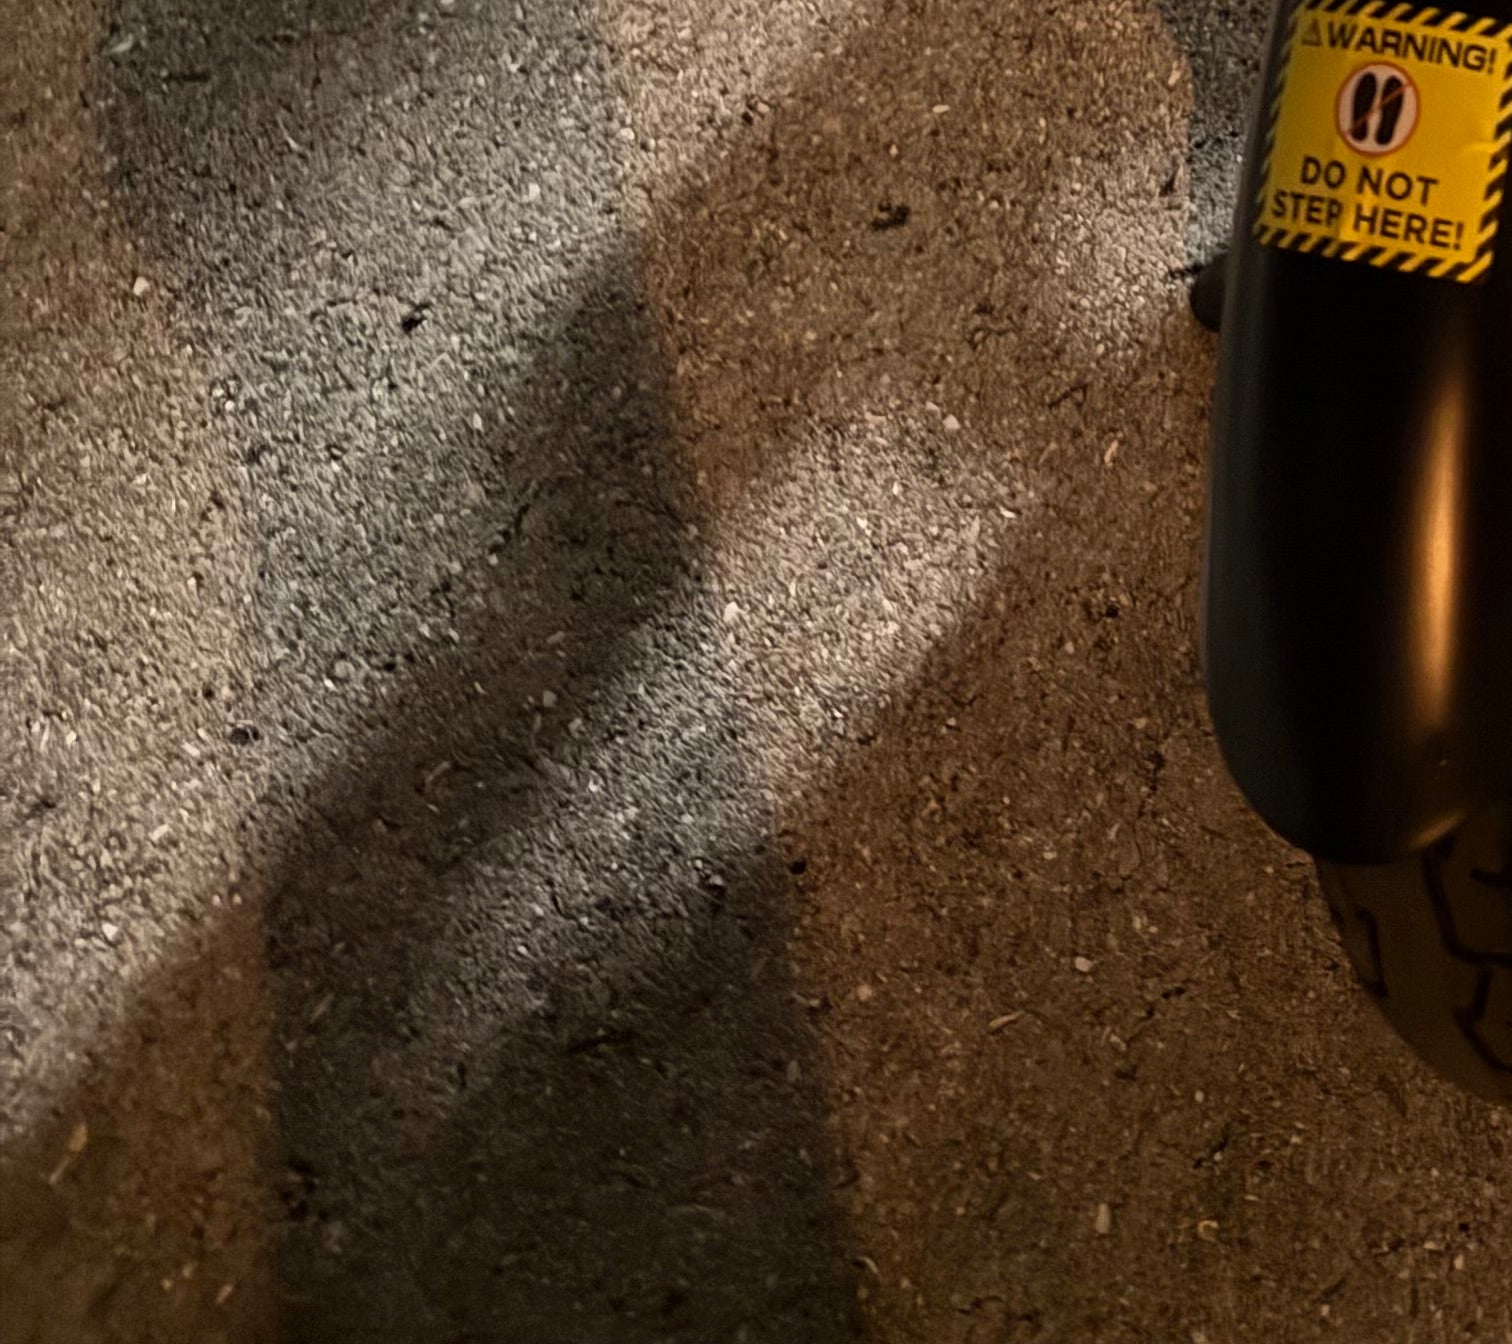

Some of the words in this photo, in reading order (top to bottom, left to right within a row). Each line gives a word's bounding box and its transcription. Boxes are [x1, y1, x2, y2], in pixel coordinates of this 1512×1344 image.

[1327, 23, 1498, 76] WARNING!
[1300, 156, 1347, 190] DO
[1356, 166, 1440, 206] NOT
[1272, 189, 1343, 228] STEP
[1352, 205, 1466, 251] HERE!
